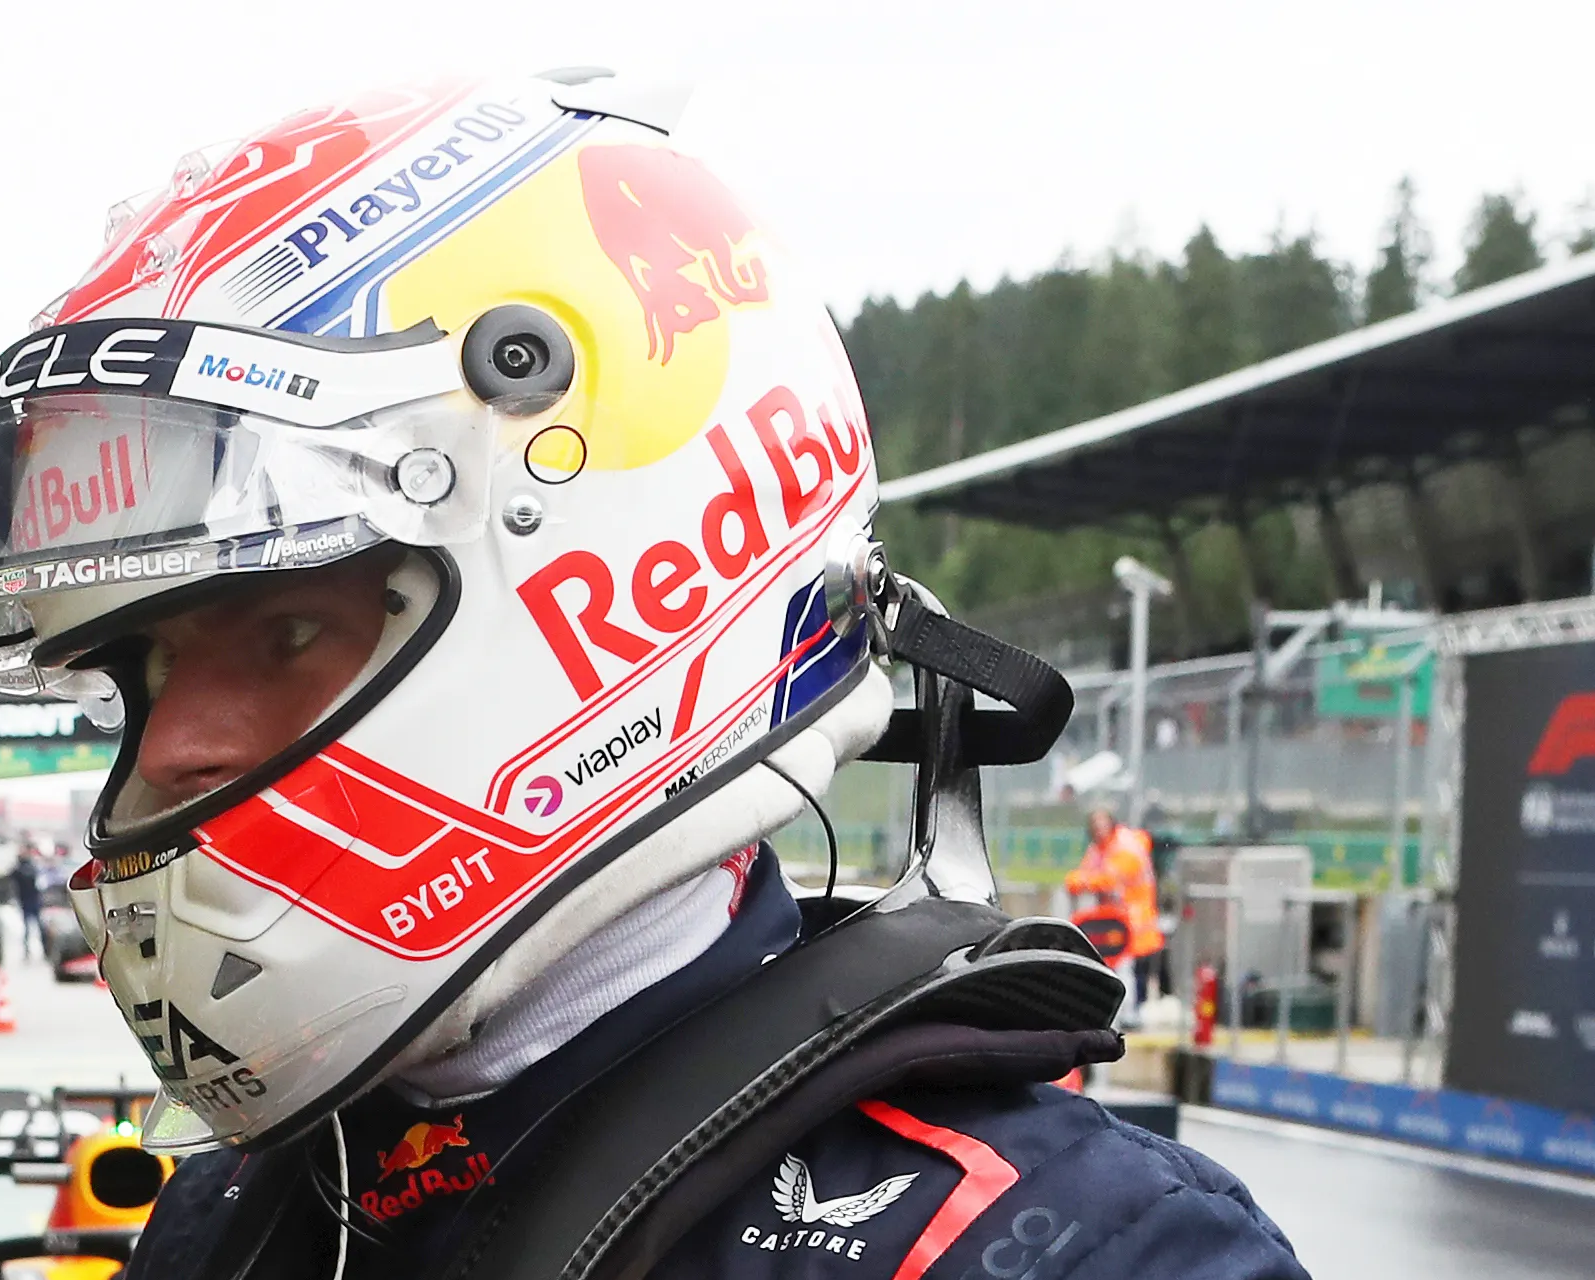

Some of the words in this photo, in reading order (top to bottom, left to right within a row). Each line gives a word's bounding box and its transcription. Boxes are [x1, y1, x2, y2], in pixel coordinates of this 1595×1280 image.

[284, 136, 473, 269] Player
[198, 355, 286, 391] Mobil
[40, 434, 137, 541] Bull
[281, 531, 355, 558] Blenders
[516, 426, 771, 703] Red
[745, 375, 870, 529] Bu
[565, 707, 664, 787] viaplay
[380, 847, 496, 939] BYBIT
[361, 1173, 423, 1225] Red
[421, 1152, 495, 1195] Bull
